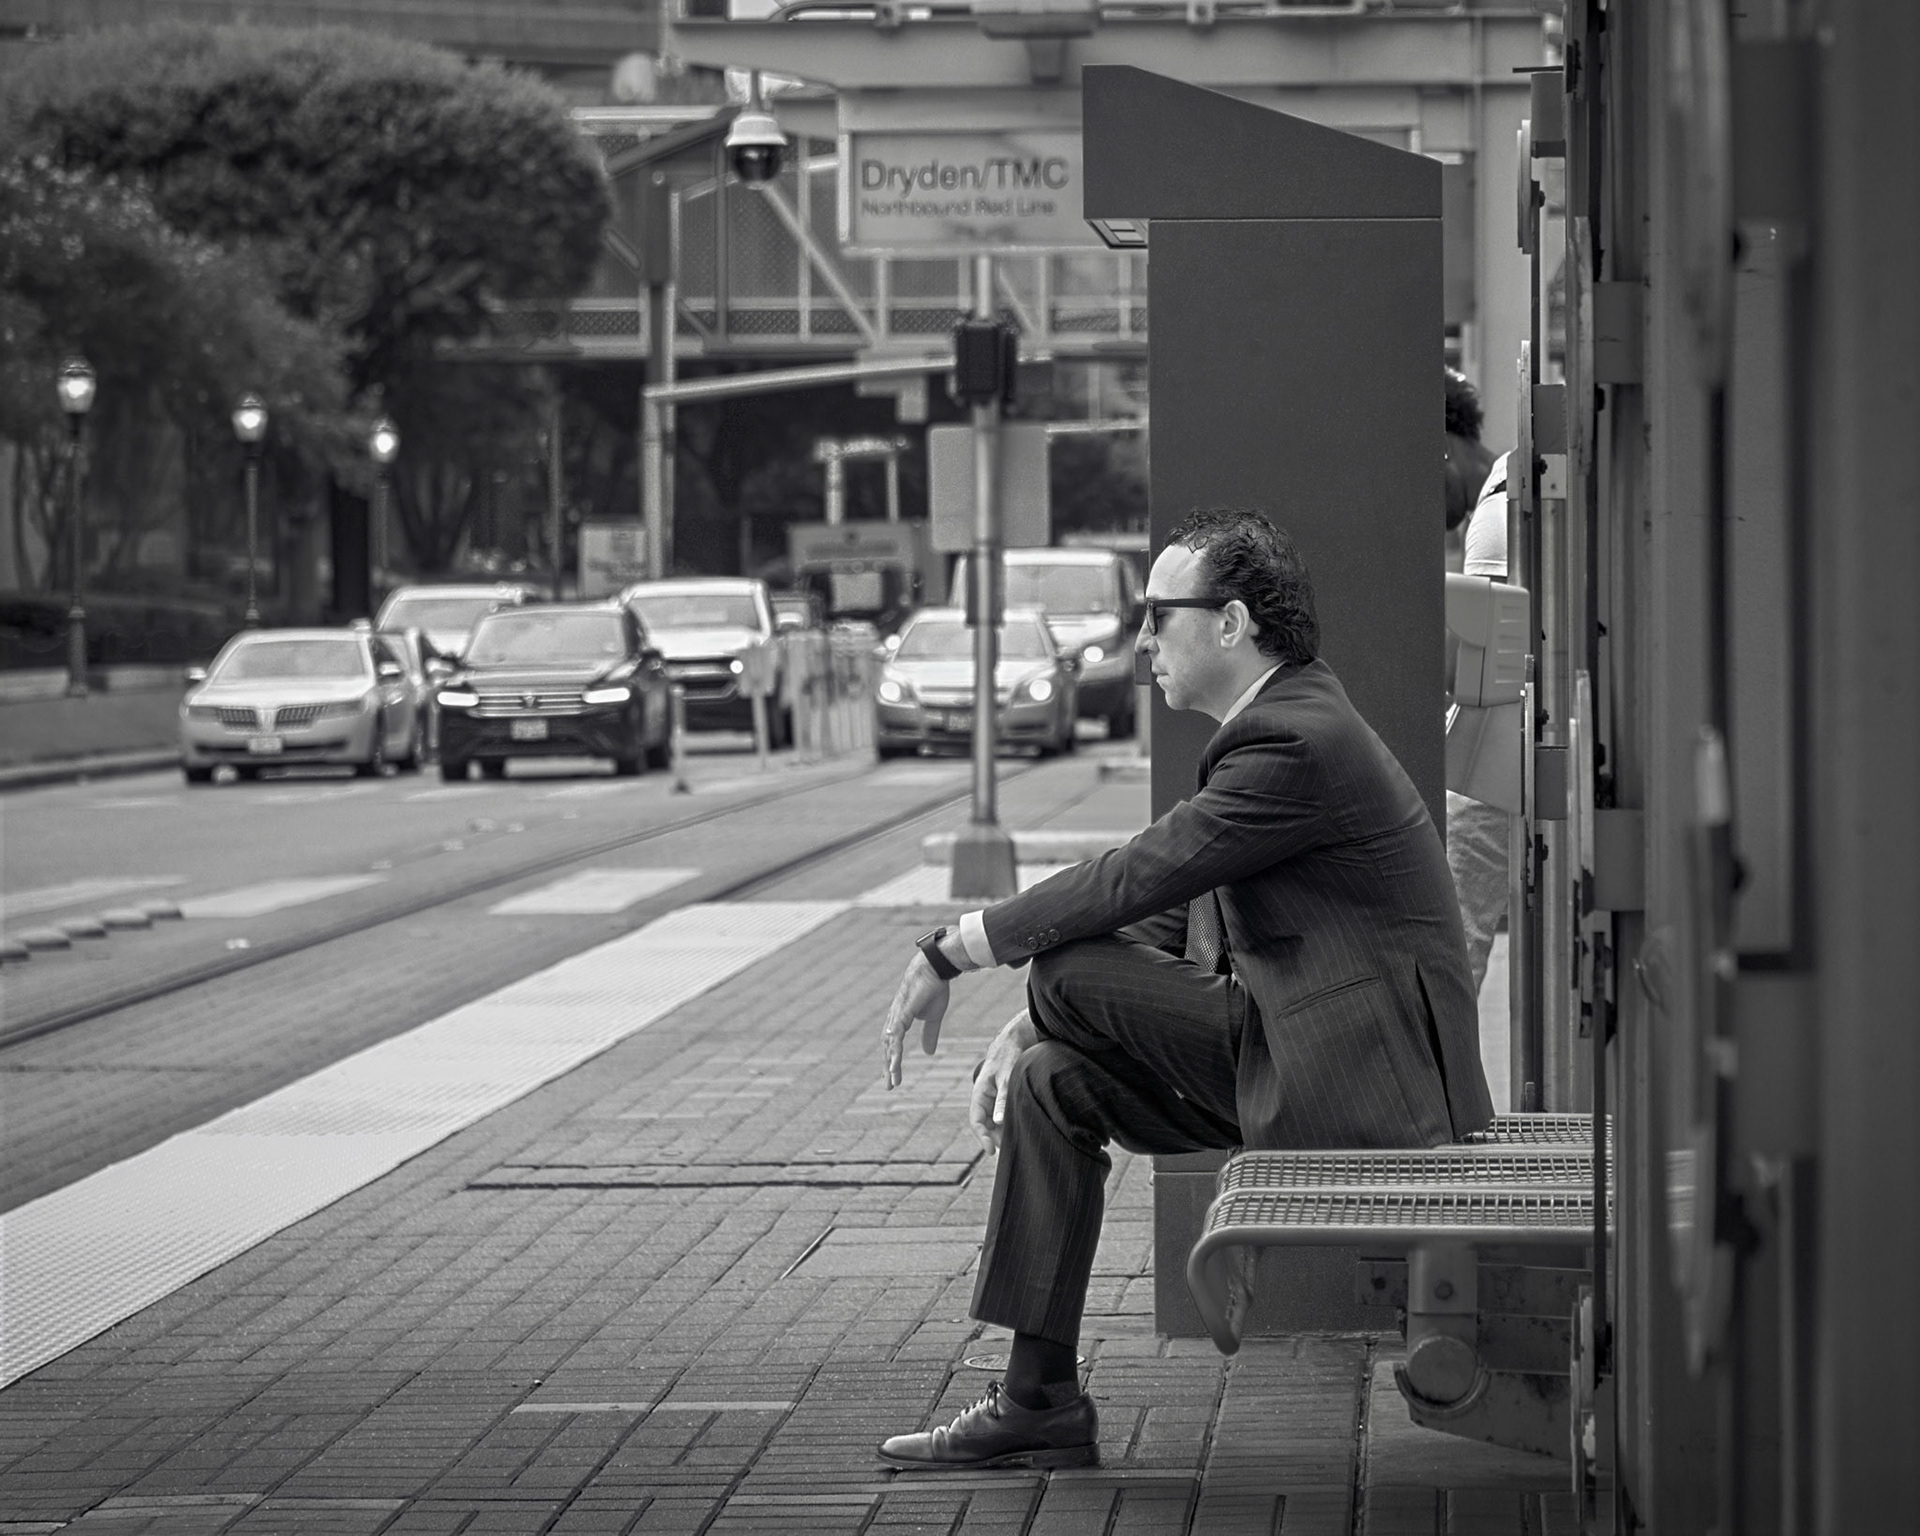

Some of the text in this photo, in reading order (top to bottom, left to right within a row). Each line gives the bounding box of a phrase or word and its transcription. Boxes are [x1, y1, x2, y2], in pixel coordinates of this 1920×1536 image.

[861, 157, 1069, 198] Dryden/TMC
[861, 199, 1057, 217] Northbound Red Line
